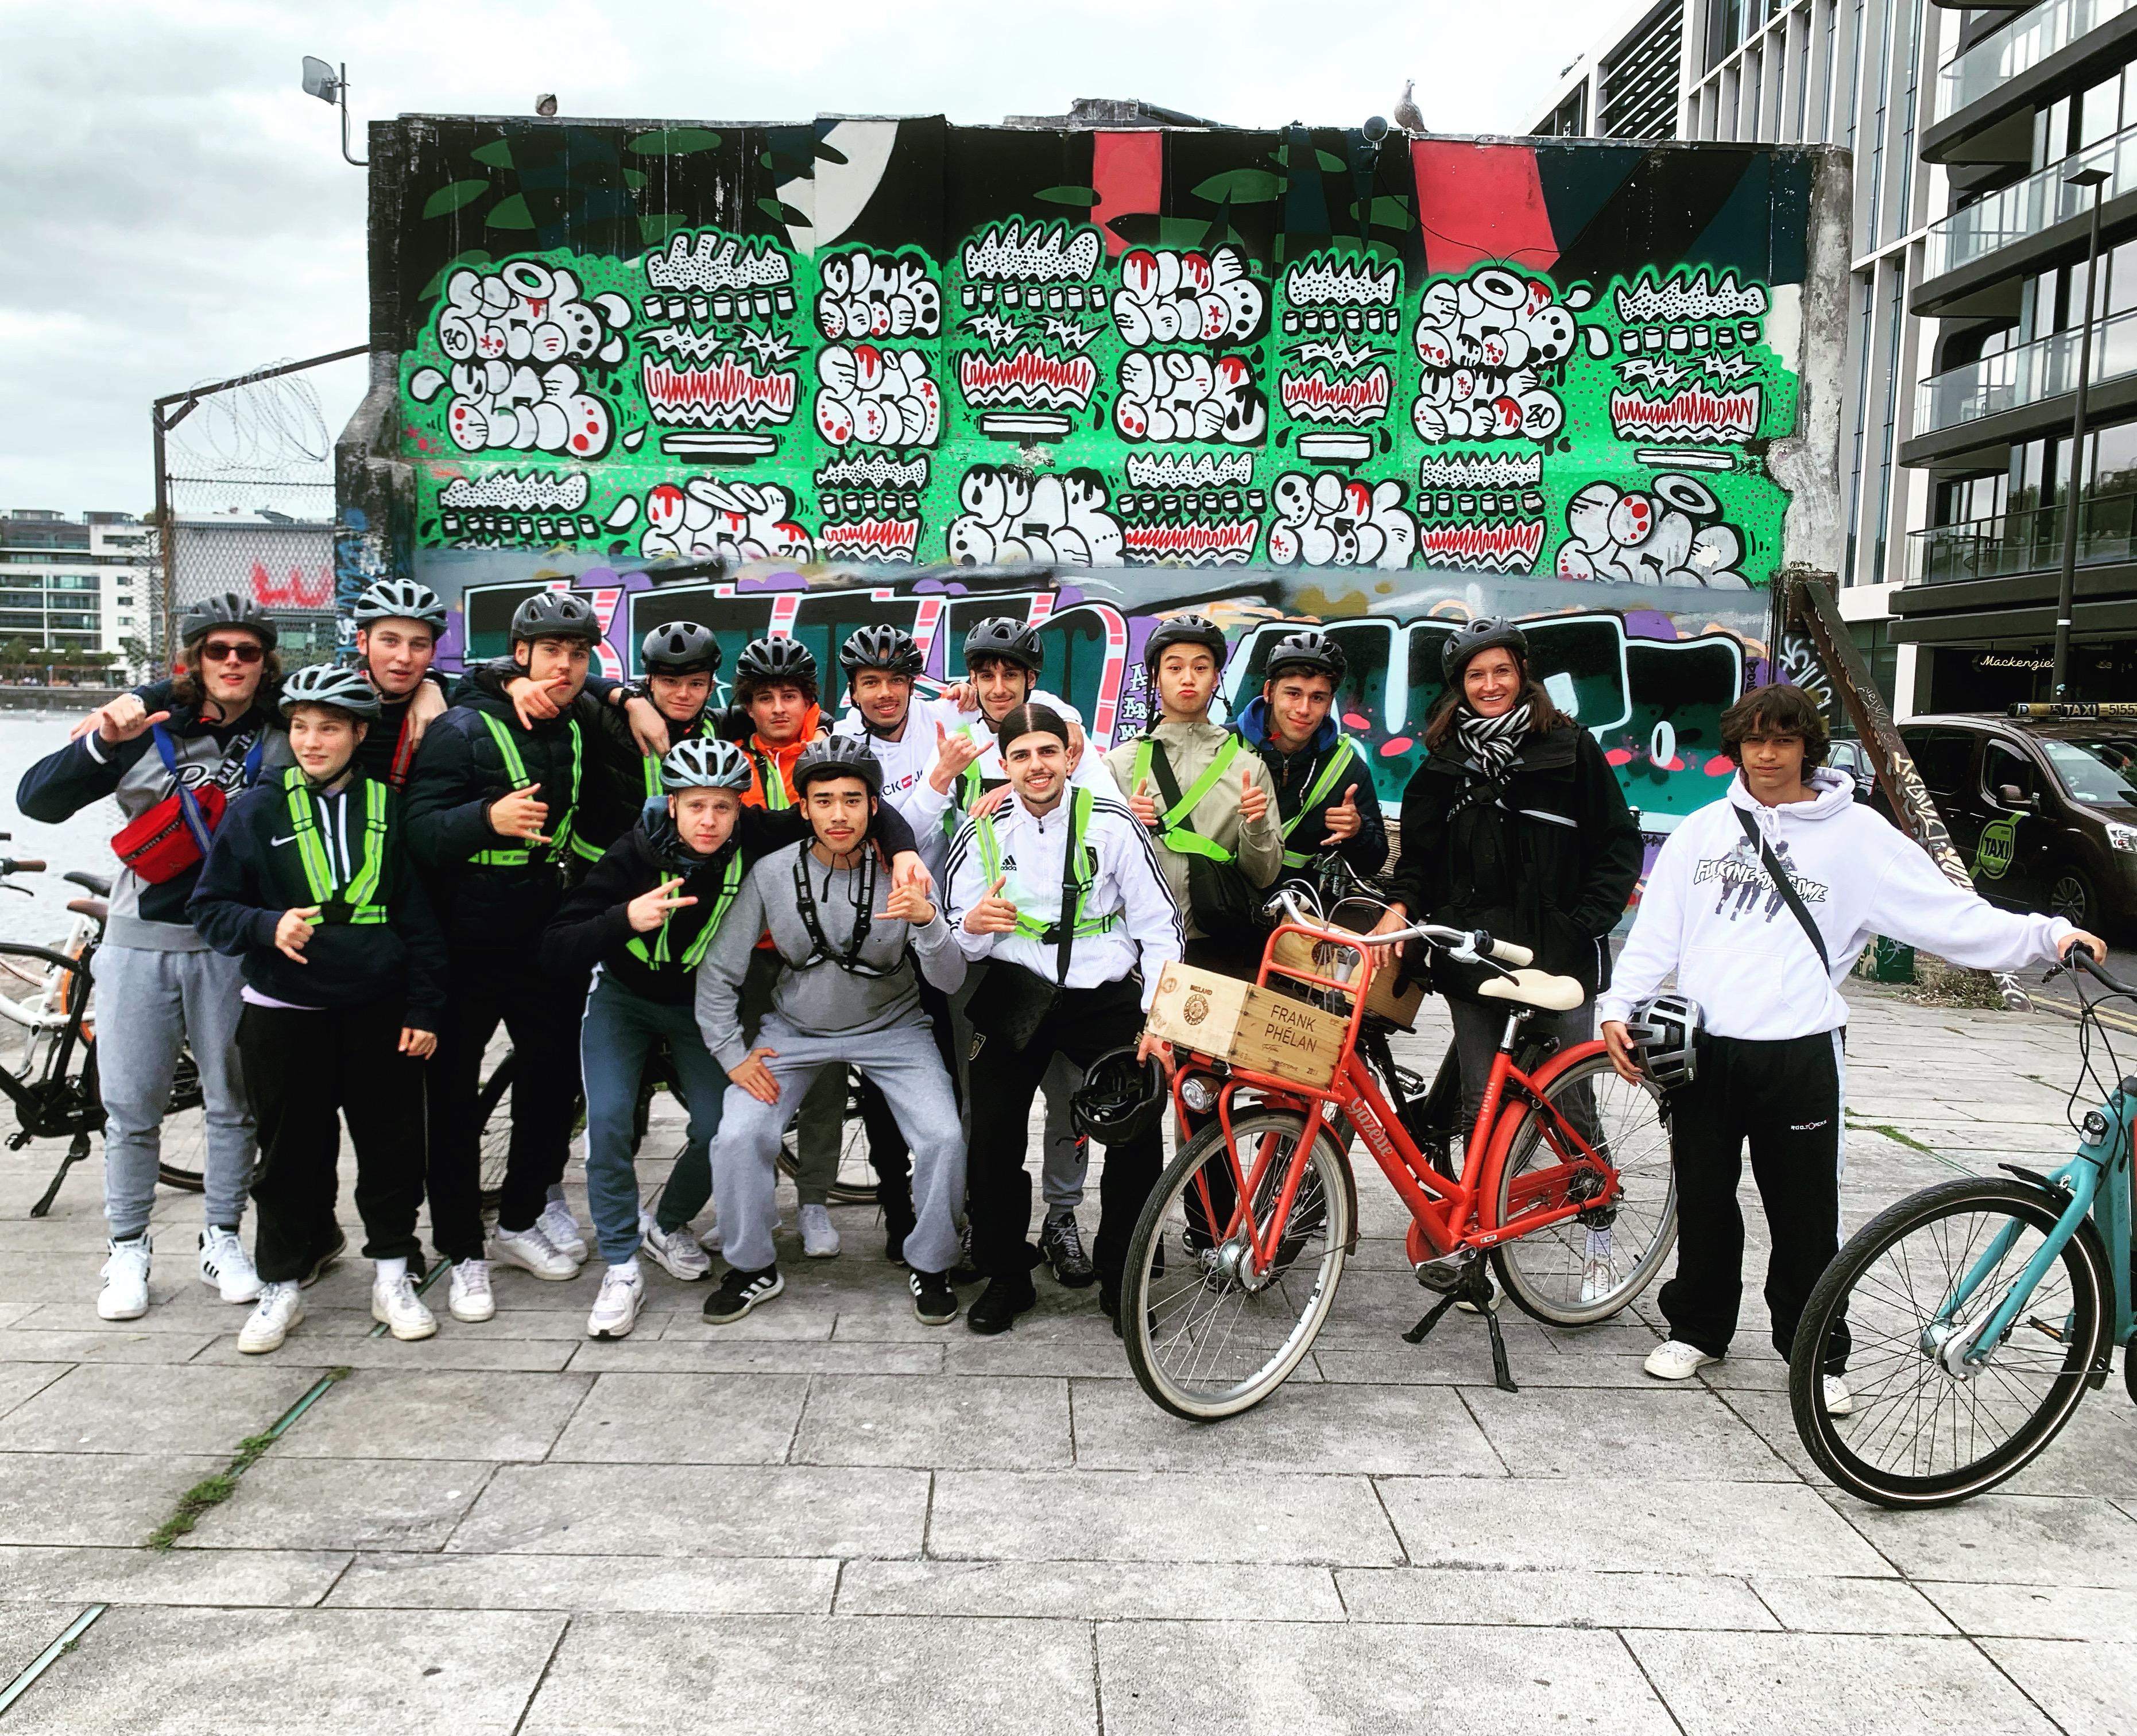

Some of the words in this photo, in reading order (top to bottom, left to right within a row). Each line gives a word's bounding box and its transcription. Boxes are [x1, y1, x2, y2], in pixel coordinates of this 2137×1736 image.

[2064, 704, 2096, 716] TAXI
[882, 781, 902, 798] CK
[1984, 836, 2010, 859] TAXI
[1190, 985, 1213, 995] IRELAND
[1271, 1005, 1317, 1032] FRANK
[1264, 1023, 1317, 1053] PHÉLAN
[1344, 1096, 1393, 1157] Gazelle
